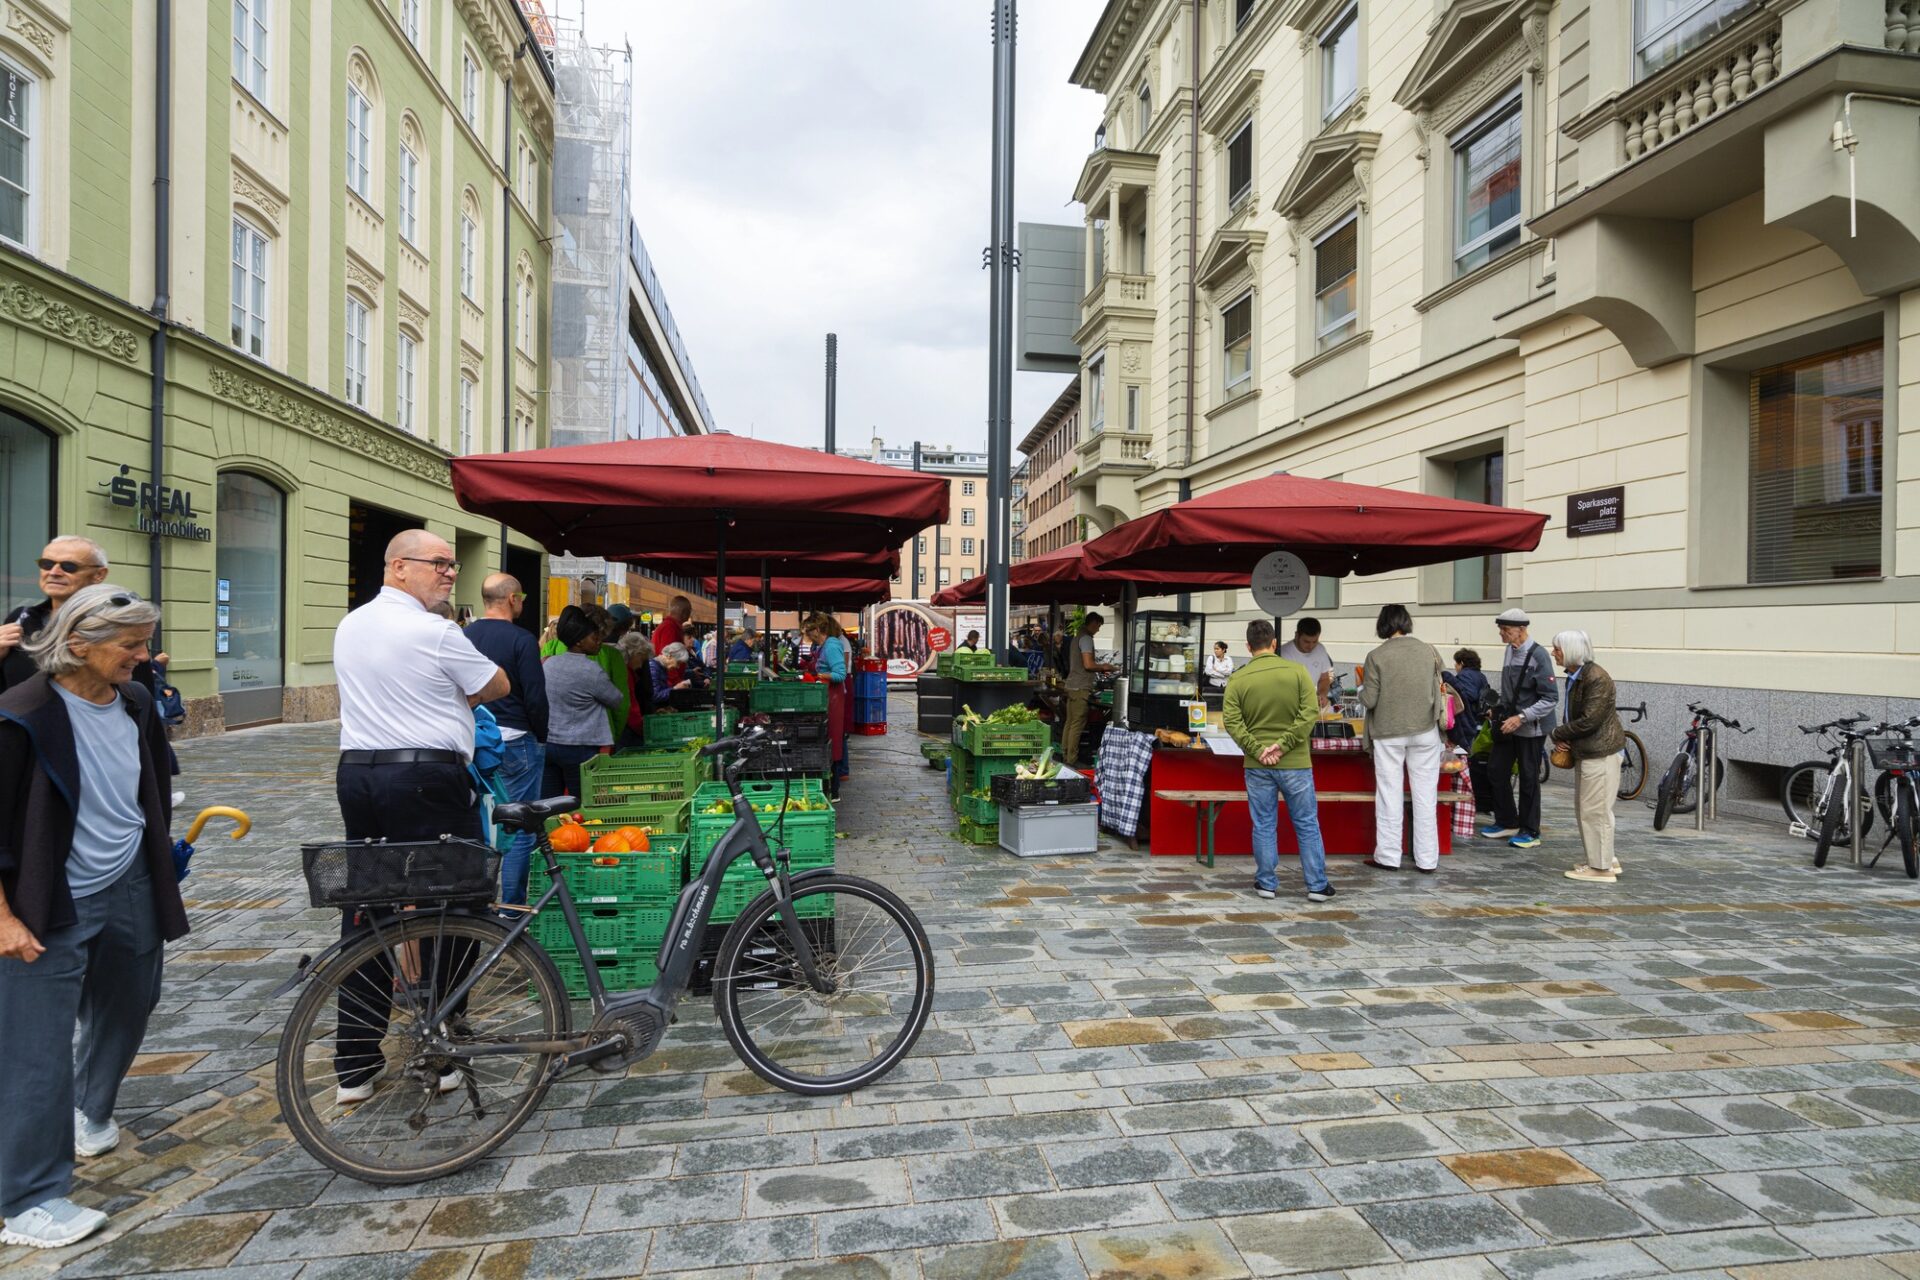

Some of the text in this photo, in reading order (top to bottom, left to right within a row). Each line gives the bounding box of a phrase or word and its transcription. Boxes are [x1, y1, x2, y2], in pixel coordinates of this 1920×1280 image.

[140, 482, 198, 518] REAL
[1577, 497, 1620, 511] Sparkassen-
[1599, 507, 1617, 518] platz
[139, 514, 212, 541] Immobilien
